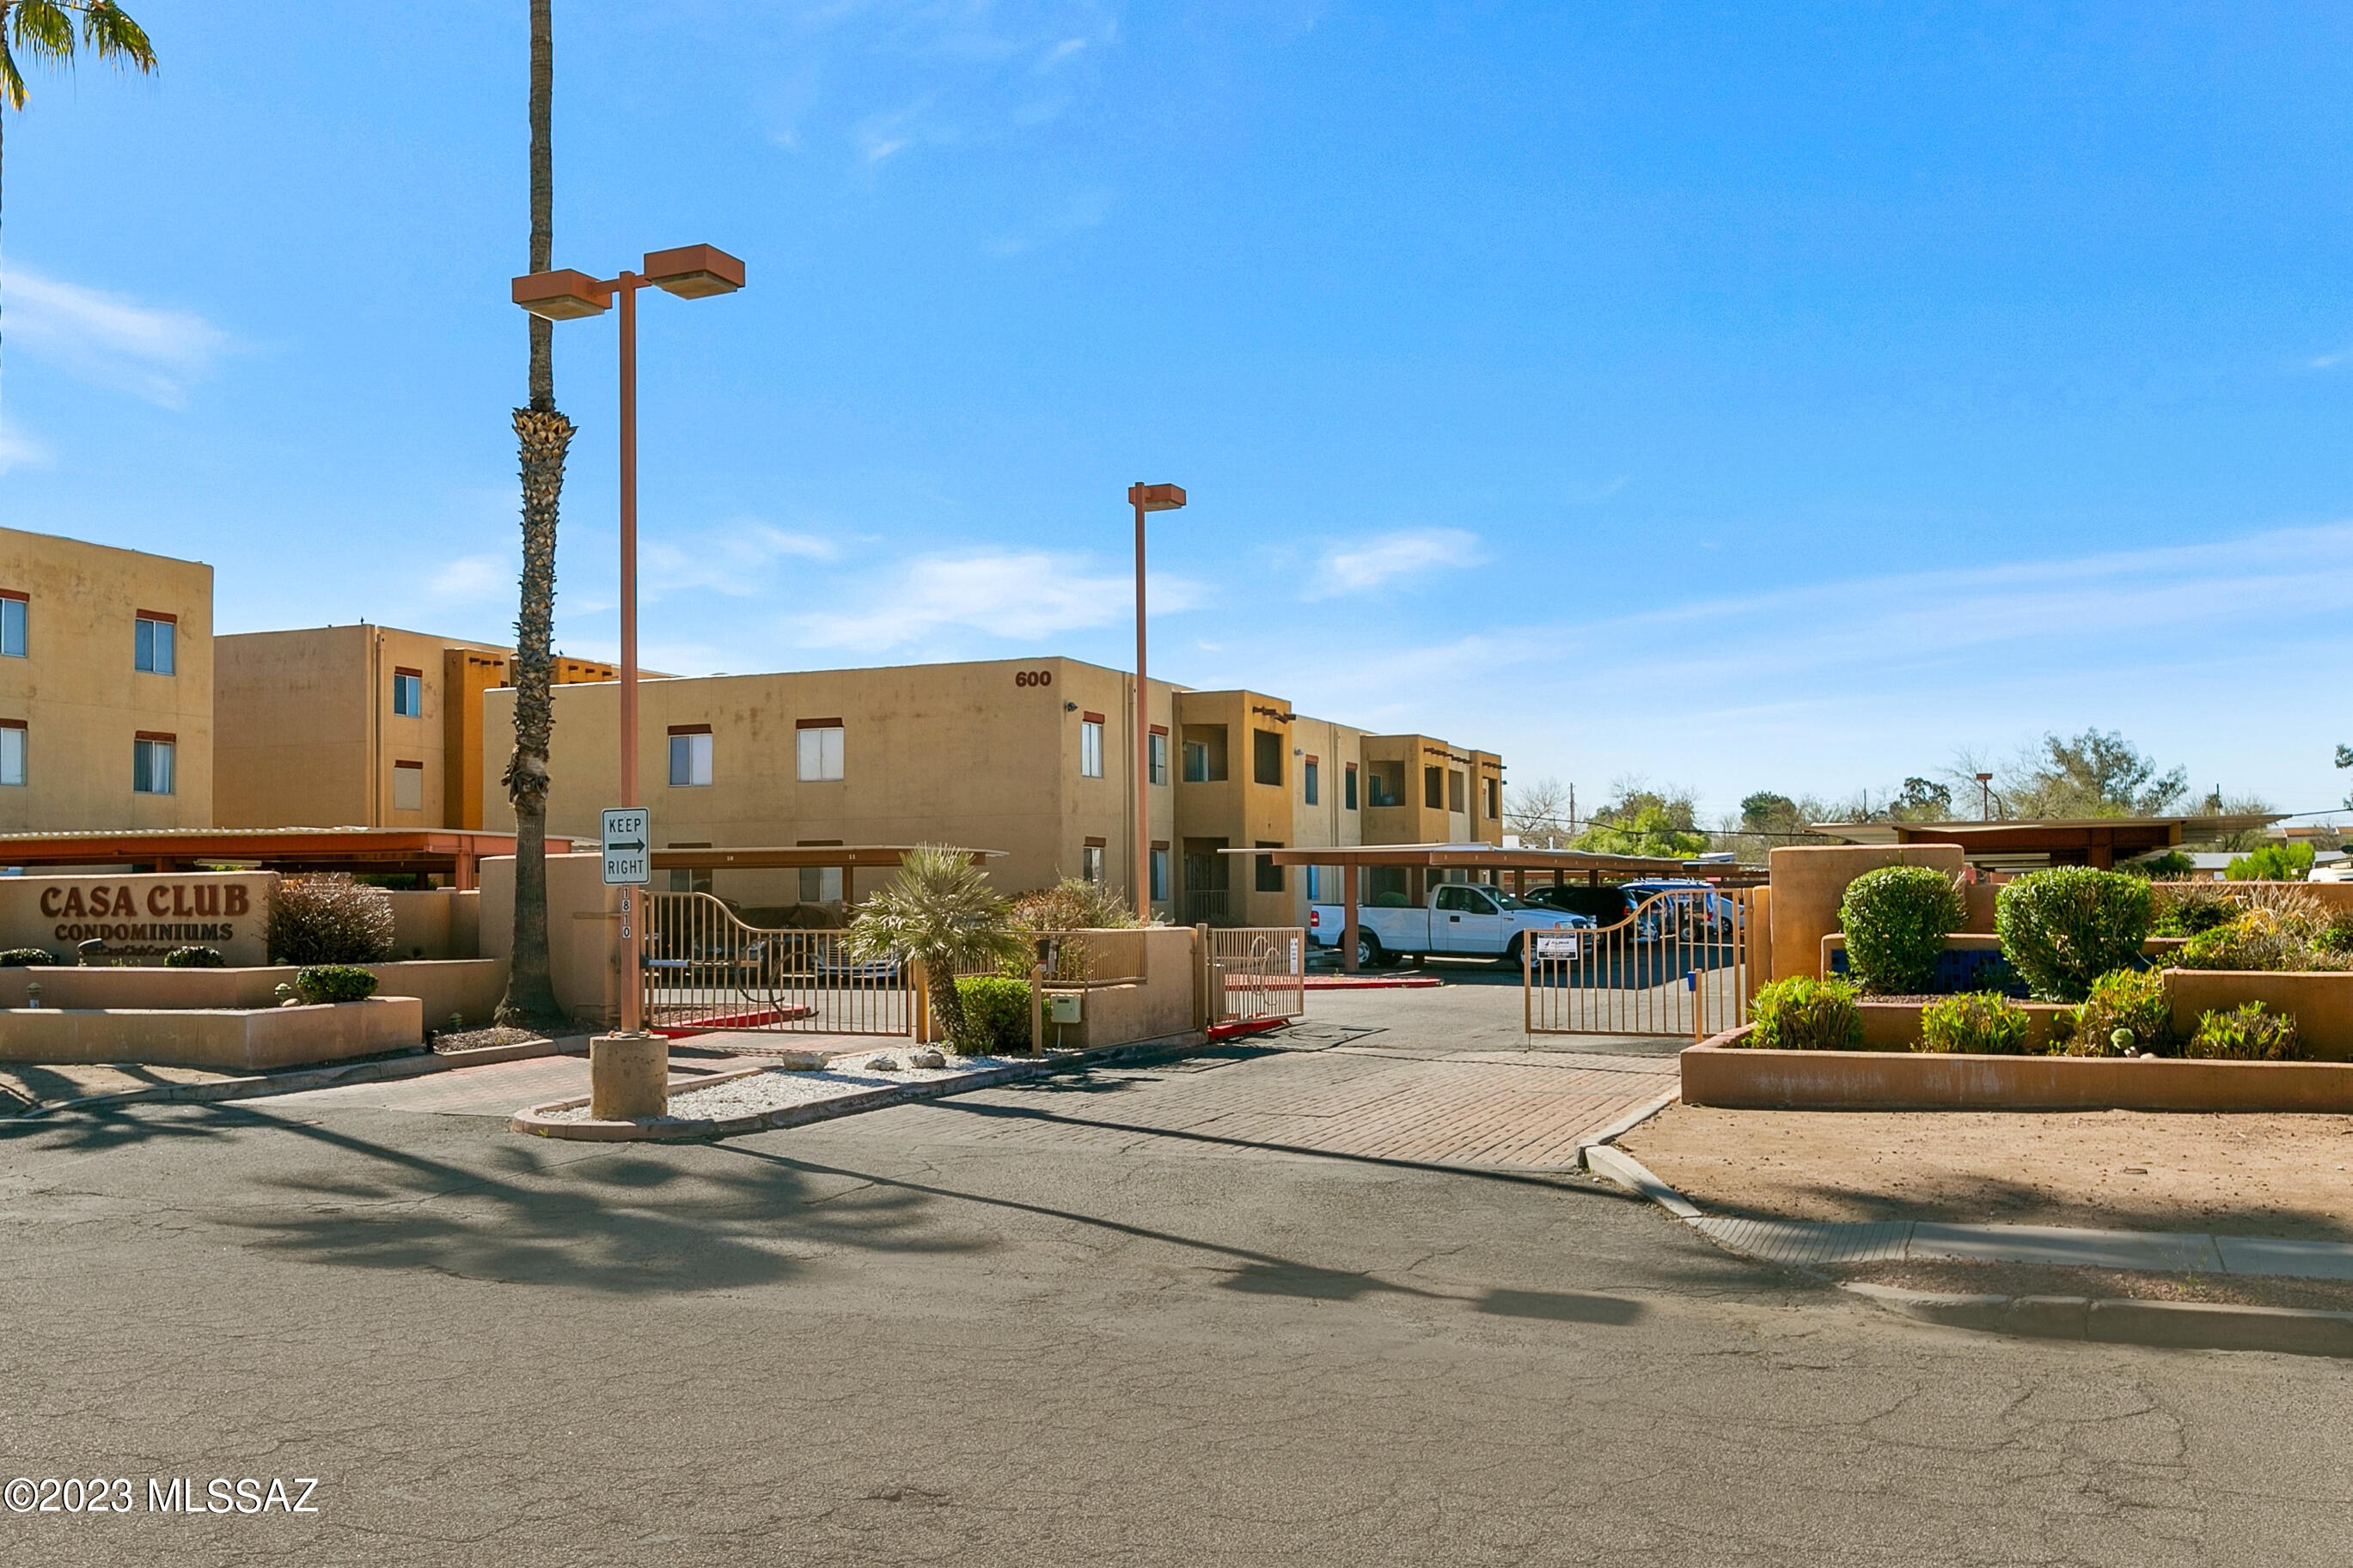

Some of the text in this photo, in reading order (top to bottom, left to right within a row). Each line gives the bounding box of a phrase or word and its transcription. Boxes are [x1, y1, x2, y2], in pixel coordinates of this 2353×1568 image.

[1015, 670, 1052, 687] 600
[609, 818, 641, 833] KEEP
[608, 860, 644, 874] RIGHT
[40, 884, 249, 917] CASA CLUB
[55, 923, 233, 941] CONDOMINIUMS
